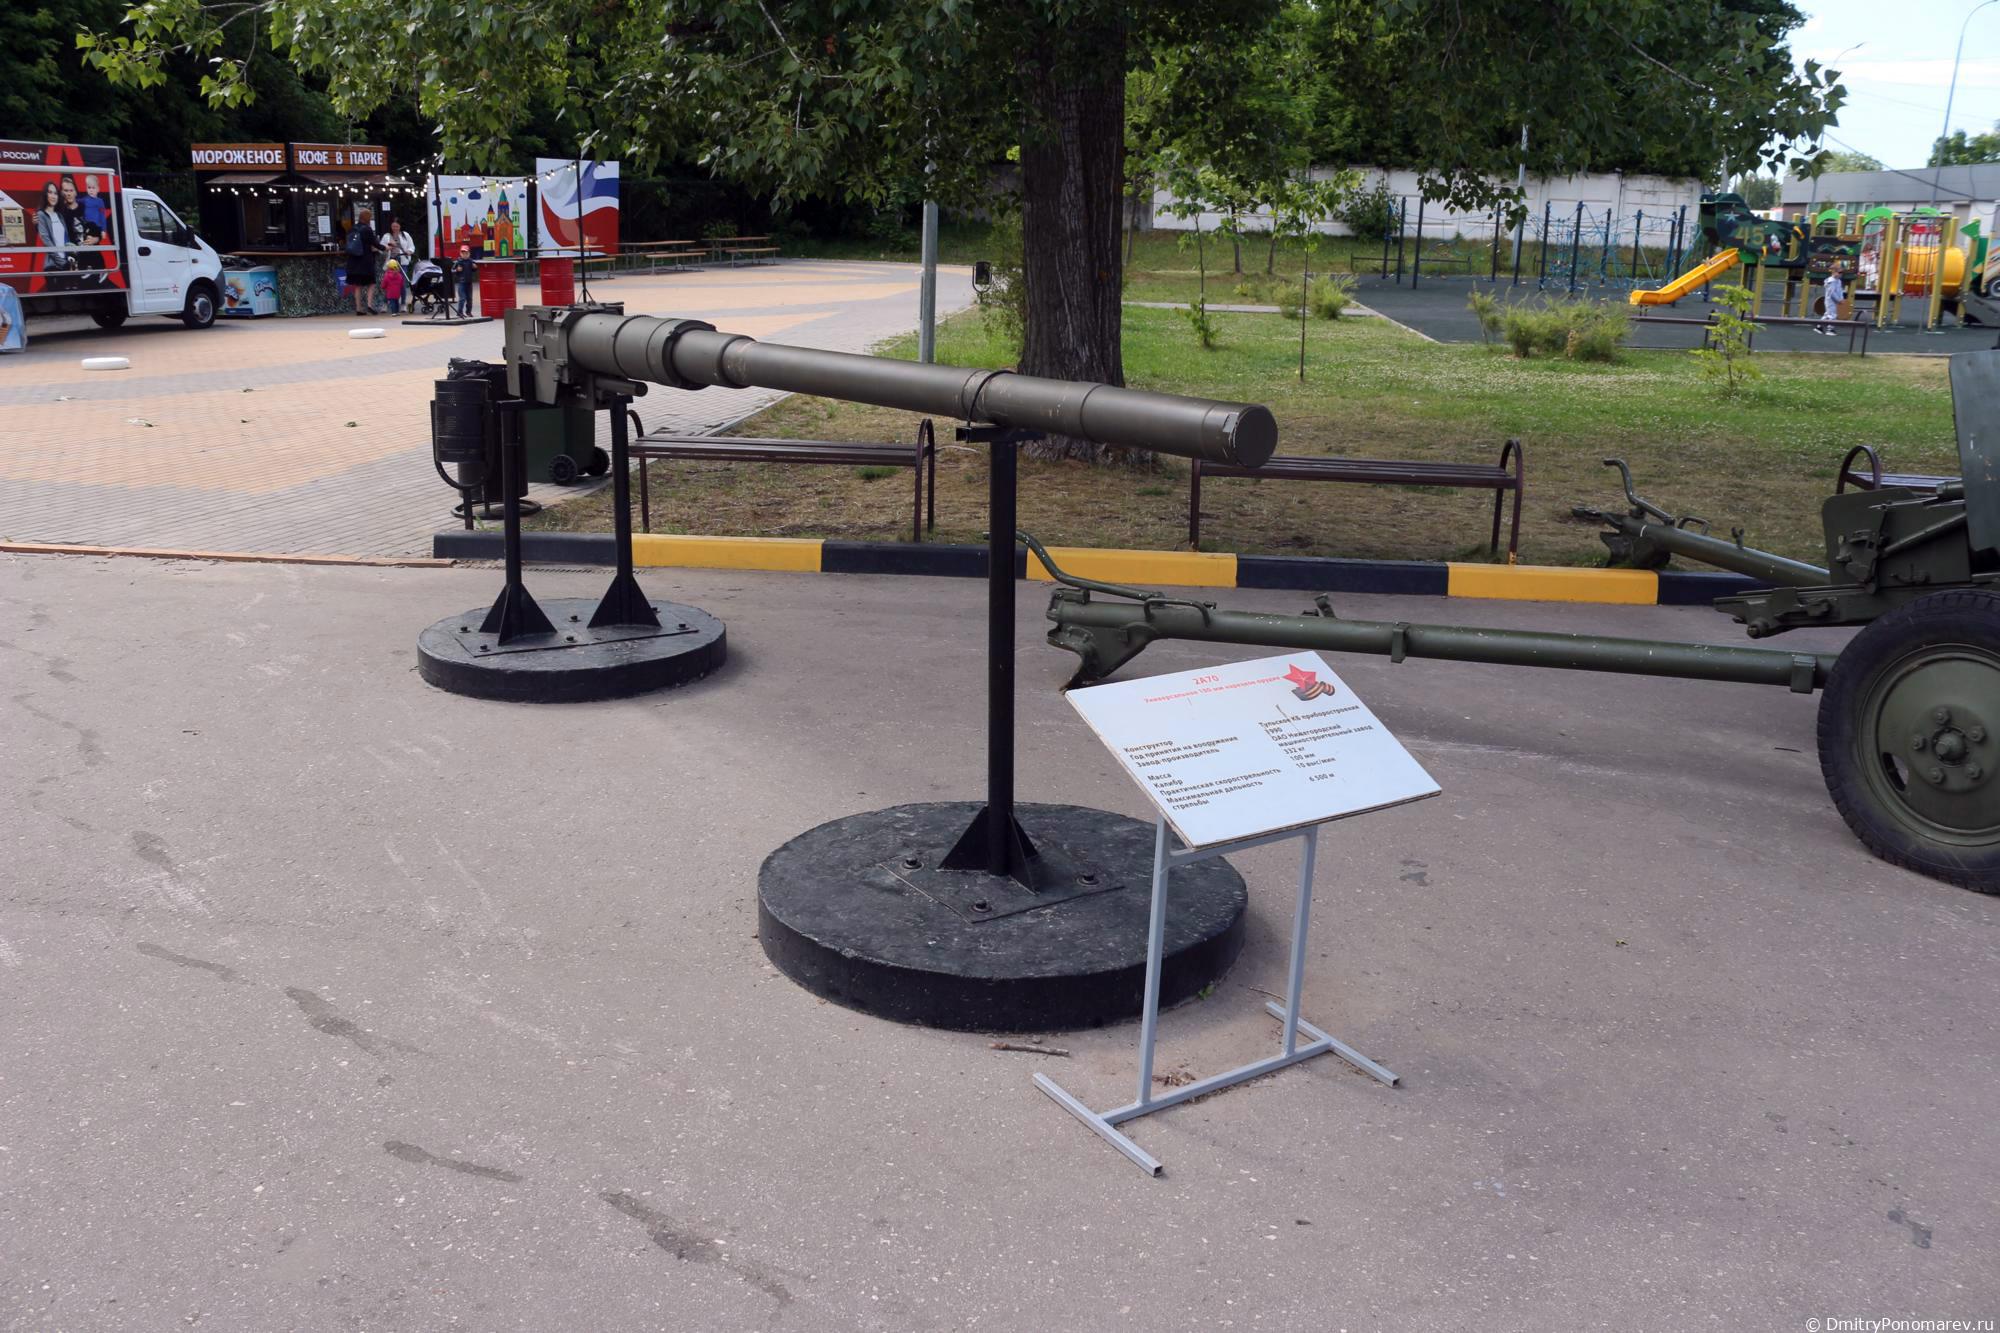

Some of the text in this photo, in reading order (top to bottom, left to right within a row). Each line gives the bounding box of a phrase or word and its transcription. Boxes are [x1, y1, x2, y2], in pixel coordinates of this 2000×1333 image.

[3, 151, 40, 160] РОССИИ
[192, 149, 283, 164] МОРОЖЕНОЕ
[298, 150, 384, 166] КОФЕ В ПАРКЕ
[1735, 226, 1765, 246] 45
[1192, 675, 1220, 685] 2А70
[1258, 718, 1291, 728] Тульское
[1301, 705, 1360, 721] приборостроения
[1271, 724, 1342, 742] ОАО Нижегородский
[1278, 724, 1374, 747] машиностроительный завод
[1123, 740, 1174, 753] Конструктор
[1130, 753, 1144, 761] Год
[1144, 747, 1182, 758] принятия
[1193, 736, 1239, 749] вооружения
[1147, 773, 1172, 782] Масса
[1153, 779, 1184, 789] Калибр
[1160, 769, 1282, 796] Практическая скорострельность
[1166, 781, 1263, 804] Максимальная дальность
[1172, 800, 1210, 811] стрельбы
